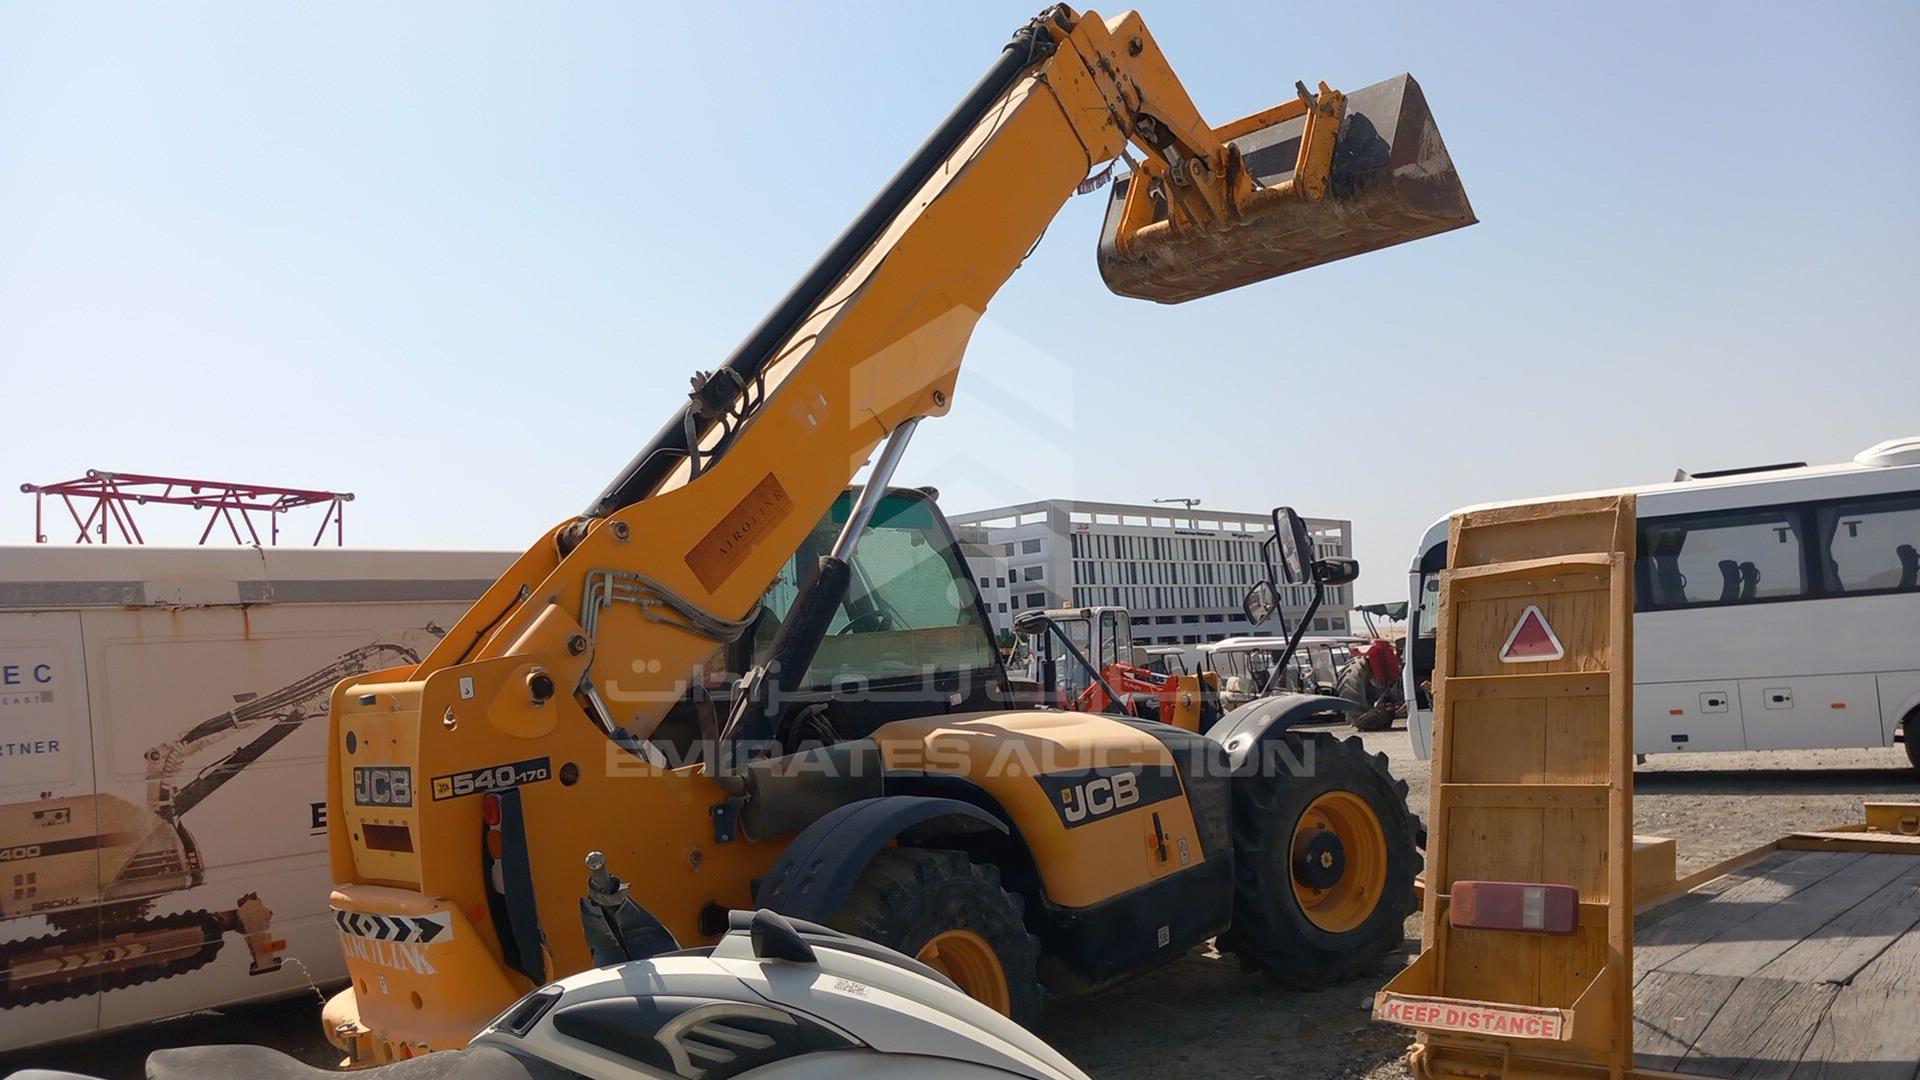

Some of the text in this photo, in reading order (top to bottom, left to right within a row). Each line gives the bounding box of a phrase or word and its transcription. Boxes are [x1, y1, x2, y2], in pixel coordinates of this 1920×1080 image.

[355, 770, 411, 803] JCB
[1064, 771, 1140, 822] JCB
[1388, 1003, 1554, 1037] KEEP DISTANCE
